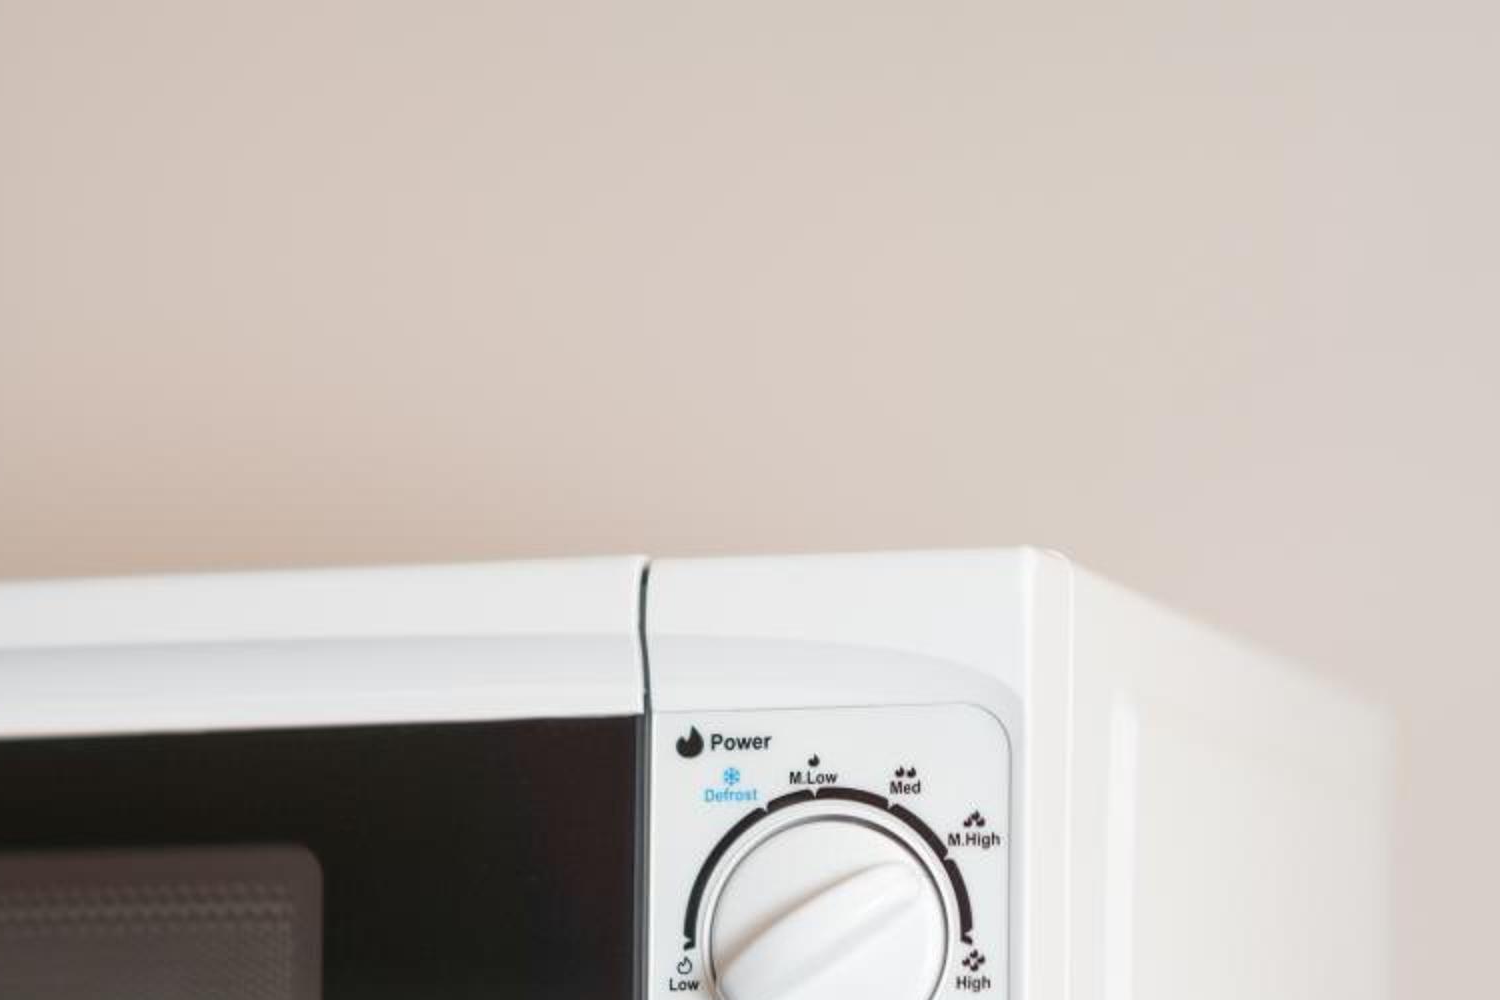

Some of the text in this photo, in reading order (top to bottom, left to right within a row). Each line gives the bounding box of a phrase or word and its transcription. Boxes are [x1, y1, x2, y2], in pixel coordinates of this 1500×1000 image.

[710, 733, 772, 751] Power
[788, 771, 838, 785] M.Low
[889, 780, 922, 795] Med
[704, 788, 758, 803] Defrost
[947, 832, 1001, 850] M.High
[668, 977, 700, 992] Low
[956, 976, 991, 992] High
